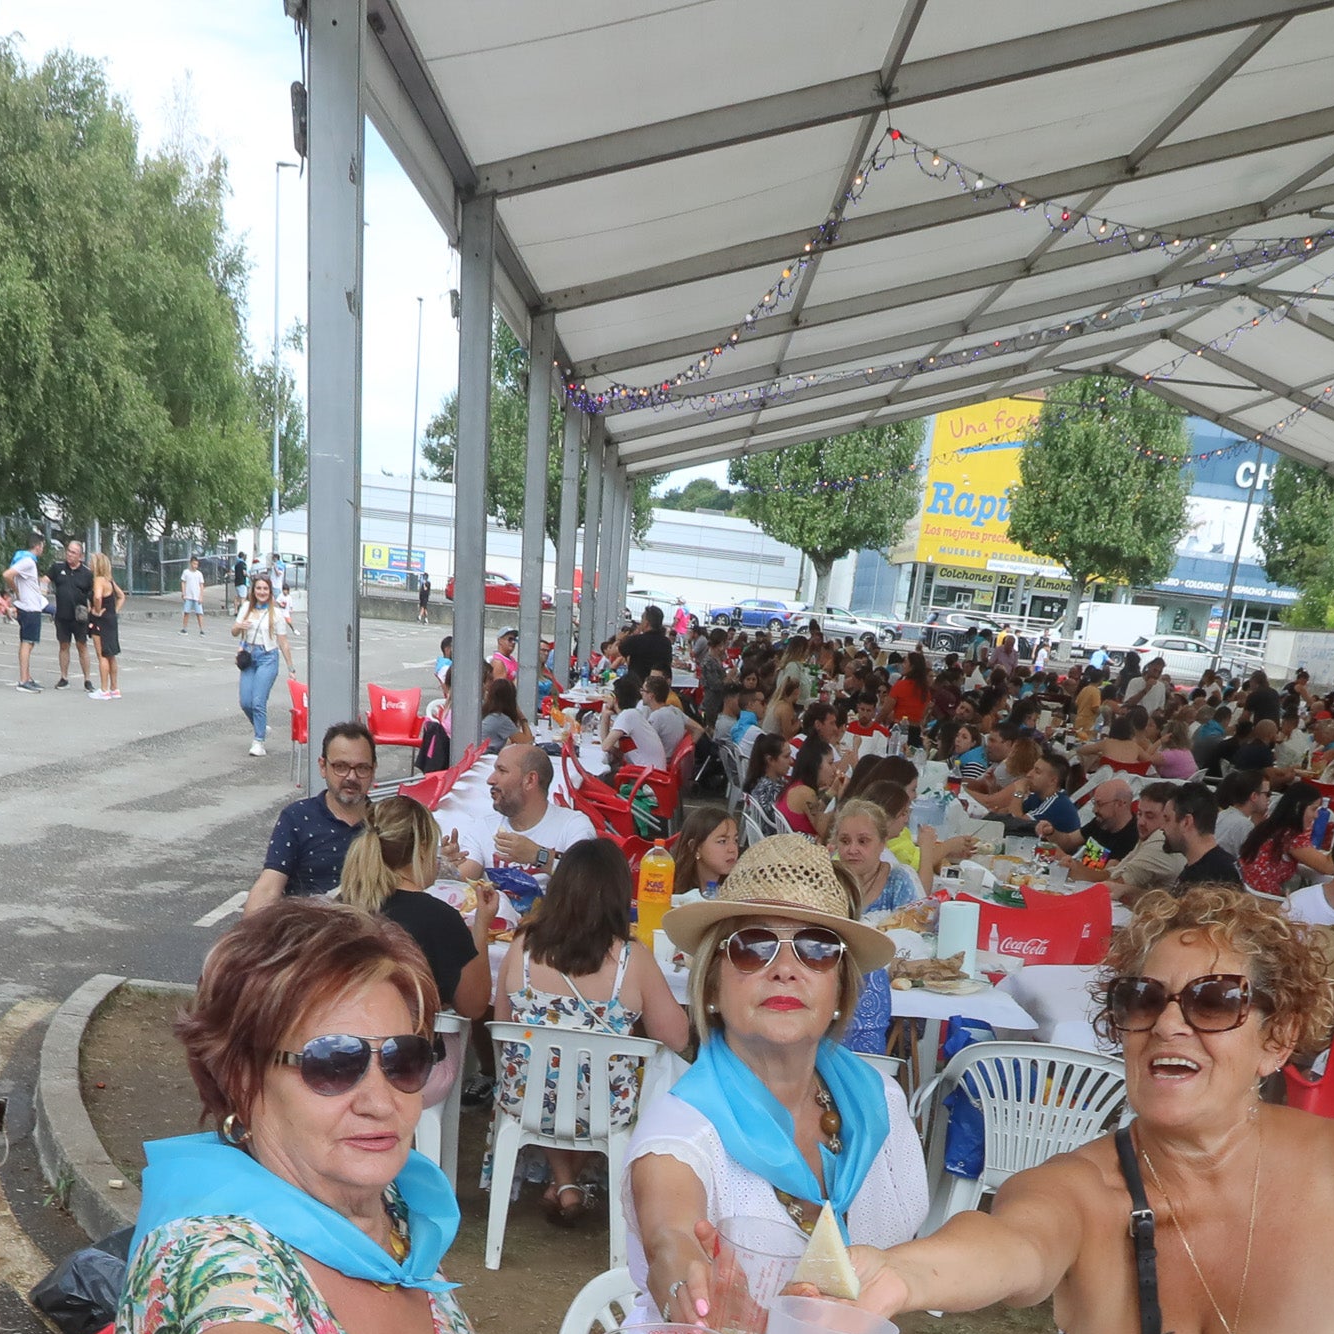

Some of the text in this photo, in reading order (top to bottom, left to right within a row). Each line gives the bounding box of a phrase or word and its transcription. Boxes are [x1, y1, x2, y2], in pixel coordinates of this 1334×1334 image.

[949, 416, 988, 439] Una
[1235, 461, 1276, 490] CH
[926, 481, 1010, 527] Rapi
[923, 523, 941, 536] Los
[943, 526, 980, 542] mejores
[938, 546, 982, 558] MUEBLES
[939, 567, 993, 583] Colchones
[1184, 578, 1225, 592] COLCHONES
[1232, 586, 1267, 597] ESPACHOS
